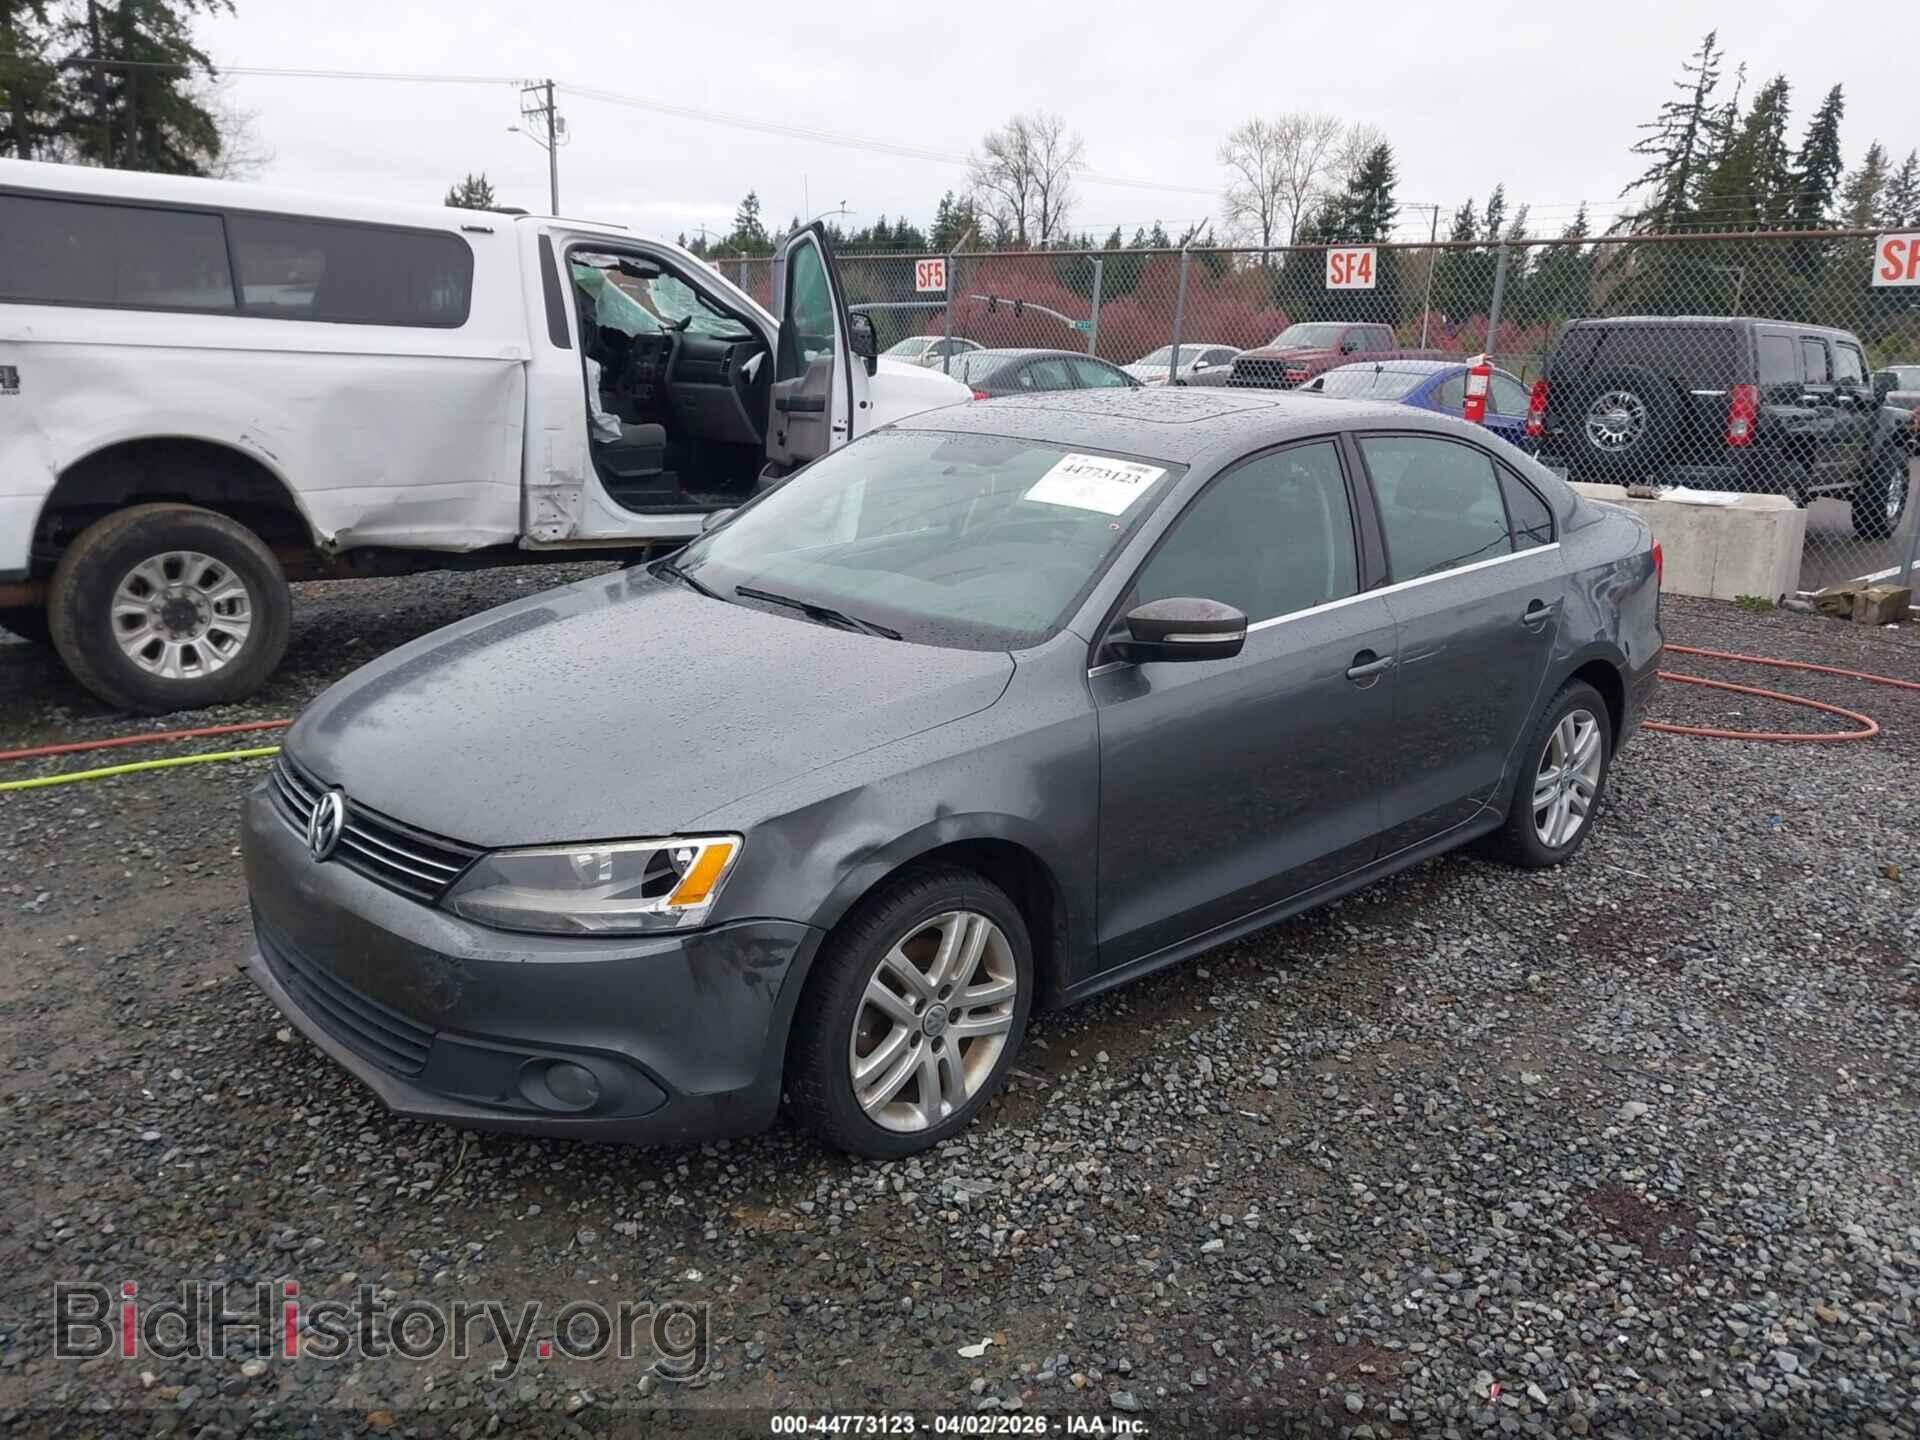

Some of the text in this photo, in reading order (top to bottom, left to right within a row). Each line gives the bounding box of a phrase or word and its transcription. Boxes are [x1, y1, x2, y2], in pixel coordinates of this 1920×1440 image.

[918, 263, 943, 287] SF5
[1331, 253, 1371, 284] SF4
[1063, 464, 1142, 485] 44773123
